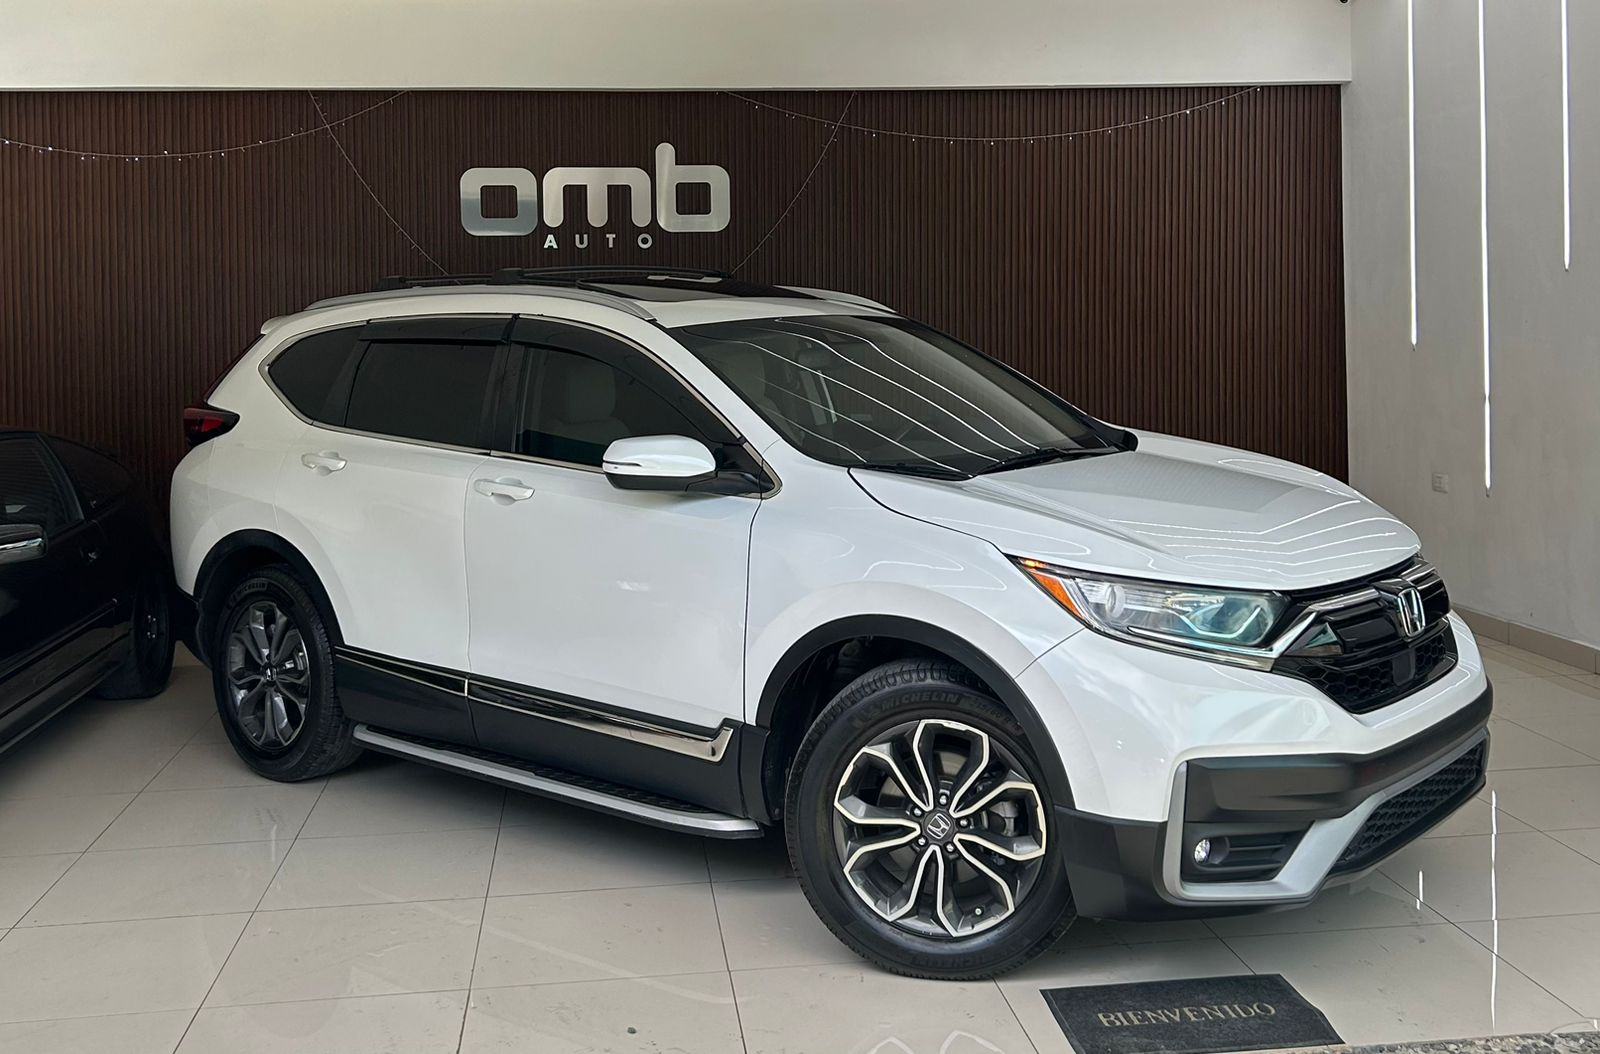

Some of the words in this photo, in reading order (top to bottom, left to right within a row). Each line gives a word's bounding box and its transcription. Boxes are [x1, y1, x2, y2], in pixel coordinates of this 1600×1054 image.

[460, 142, 731, 237] omb
[543, 233, 653, 249] AUTO
[882, 691, 960, 711] MICHELIN
[1098, 1002, 1276, 1027] BIENVENIDO
